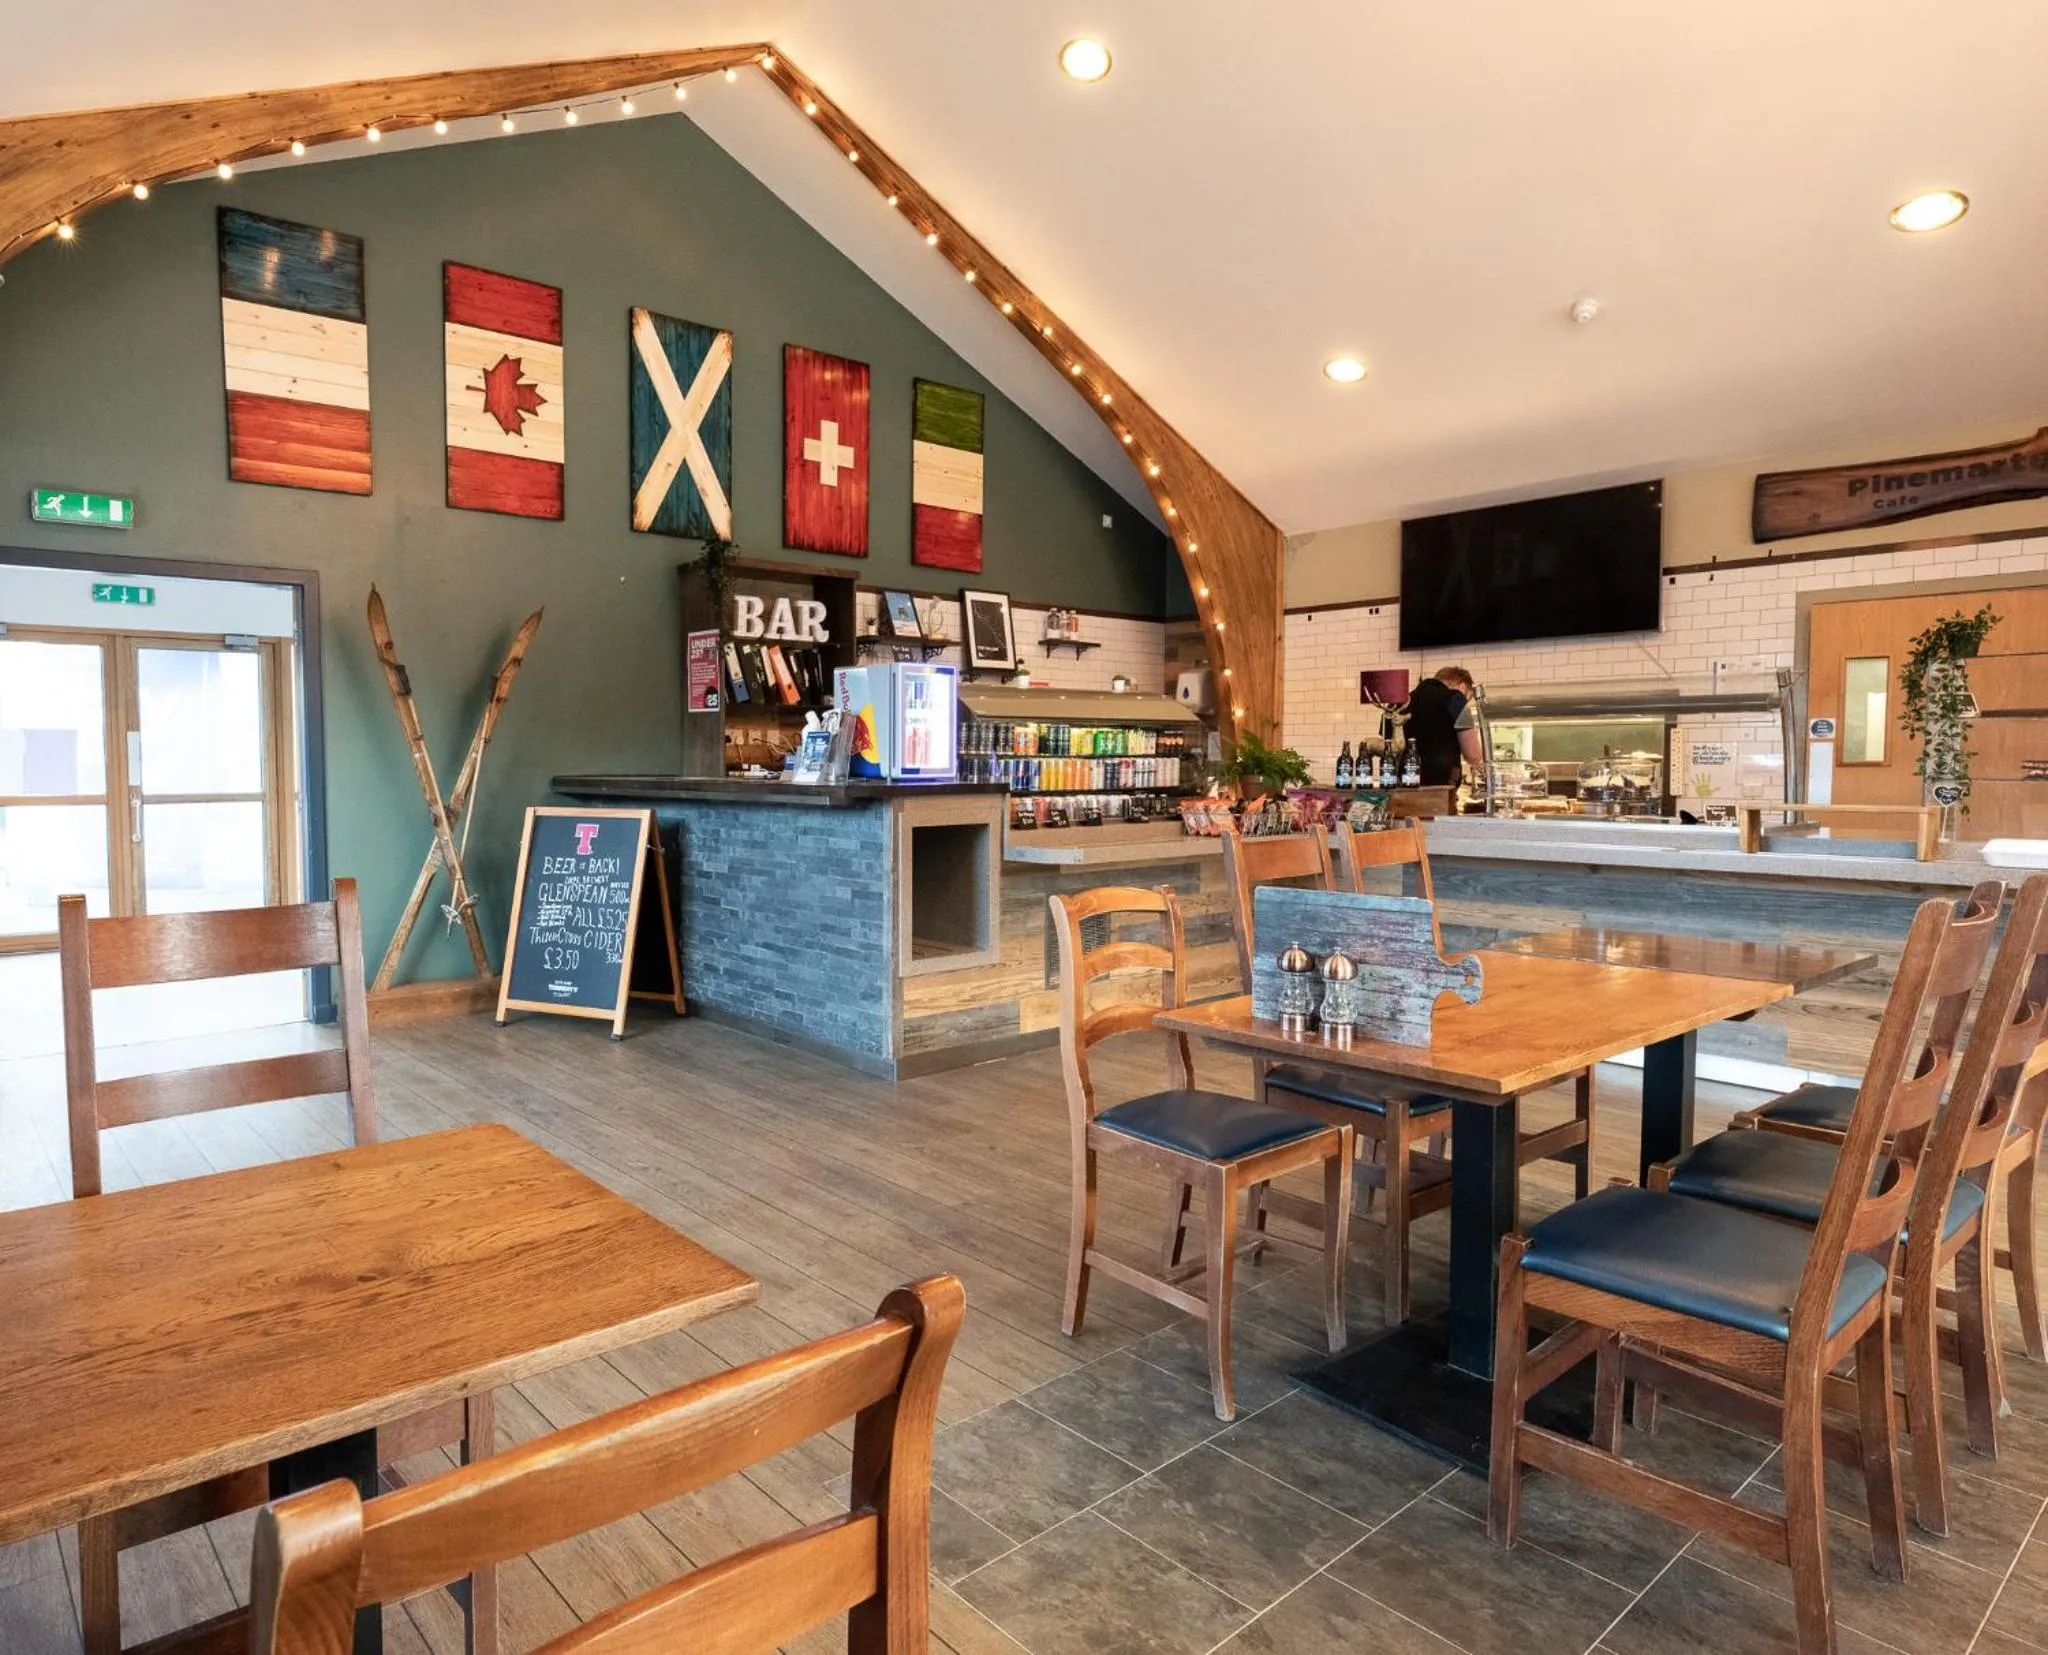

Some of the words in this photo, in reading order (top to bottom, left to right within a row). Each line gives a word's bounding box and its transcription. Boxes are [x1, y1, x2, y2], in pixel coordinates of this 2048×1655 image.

[733, 594, 829, 643] BAR
[691, 637, 716, 649] UNDER
[574, 823, 600, 856] T
[542, 856, 577, 875] BEER
[588, 857, 620, 876] BACK!
[572, 906, 596, 928] ALL
[584, 930, 622, 953] CIDER
[543, 946, 580, 970] £3.50
